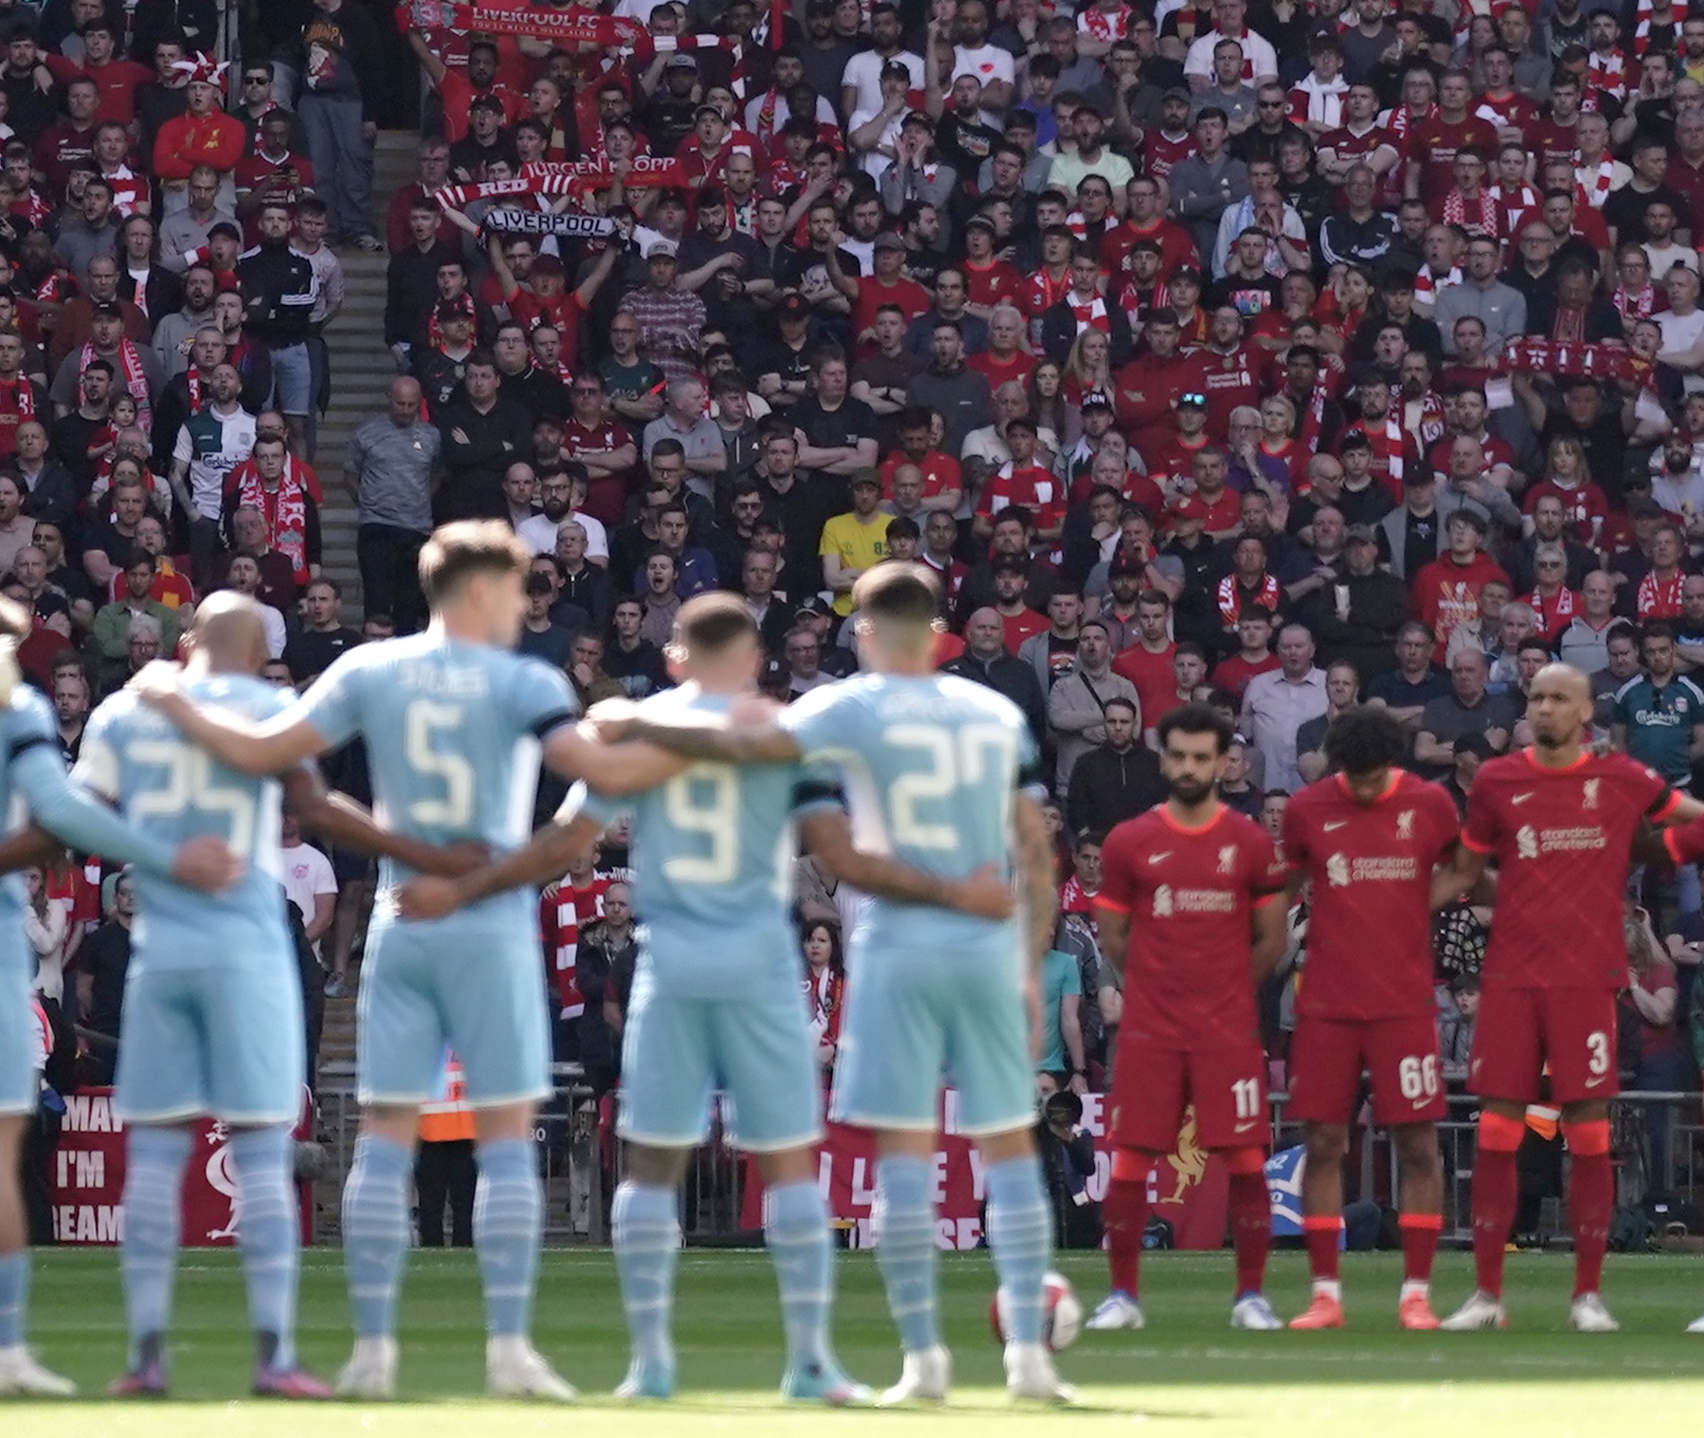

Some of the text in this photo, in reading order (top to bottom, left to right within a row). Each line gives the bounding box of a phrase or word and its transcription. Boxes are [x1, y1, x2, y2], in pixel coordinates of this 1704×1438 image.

[473, 7, 600, 31] LIVERPOOL FC
[478, 179, 529, 196] RED
[489, 213, 606, 233] LIVERPOOL
[405, 699, 474, 827] 5
[881, 719, 1018, 864] 27
[661, 758, 739, 884] 9
[1540, 827, 1601, 841] standard
[1540, 837, 1607, 852] chartered
[1586, 1032, 1608, 1075] 3
[1399, 1053, 1438, 1100] 66
[1231, 1077, 1260, 1118] 11
[56, 1150, 105, 1188] I'M
[53, 1204, 126, 1242] EAM
